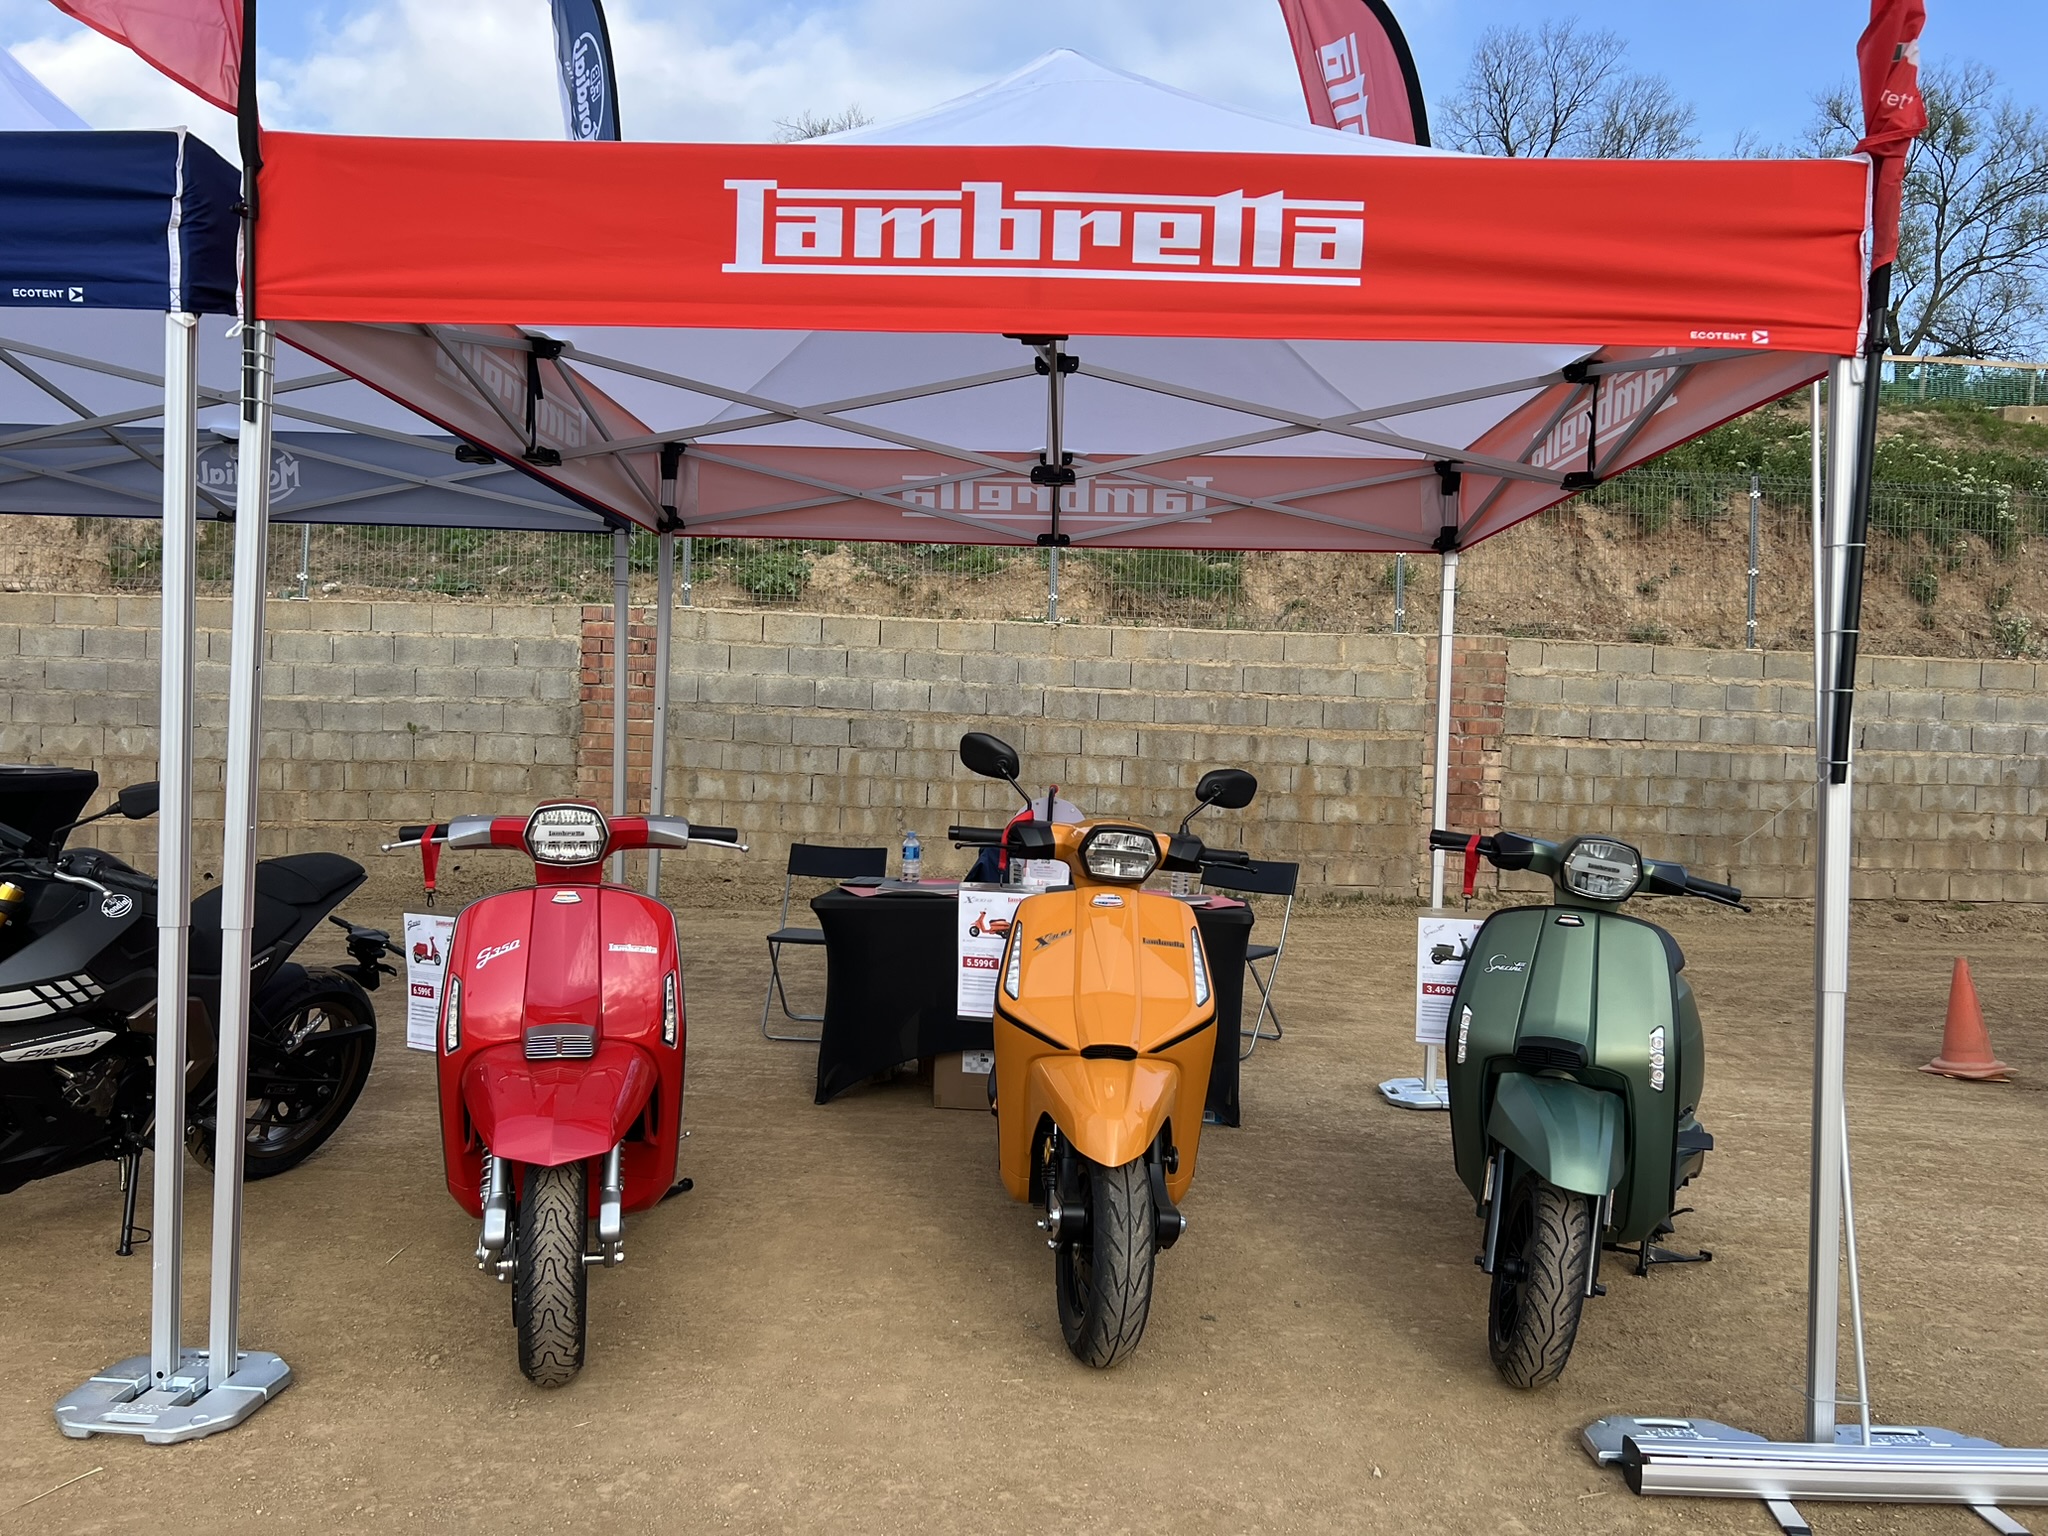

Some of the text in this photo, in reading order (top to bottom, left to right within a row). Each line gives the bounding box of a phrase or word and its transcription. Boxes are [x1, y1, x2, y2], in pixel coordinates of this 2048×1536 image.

[722, 179, 1365, 287] Lambretta
[12, 288, 64, 298] ECOTENT
[1690, 331, 1747, 340] ECOTENT
[476, 939, 520, 970] G350
[966, 958, 996, 968] 5.599€
